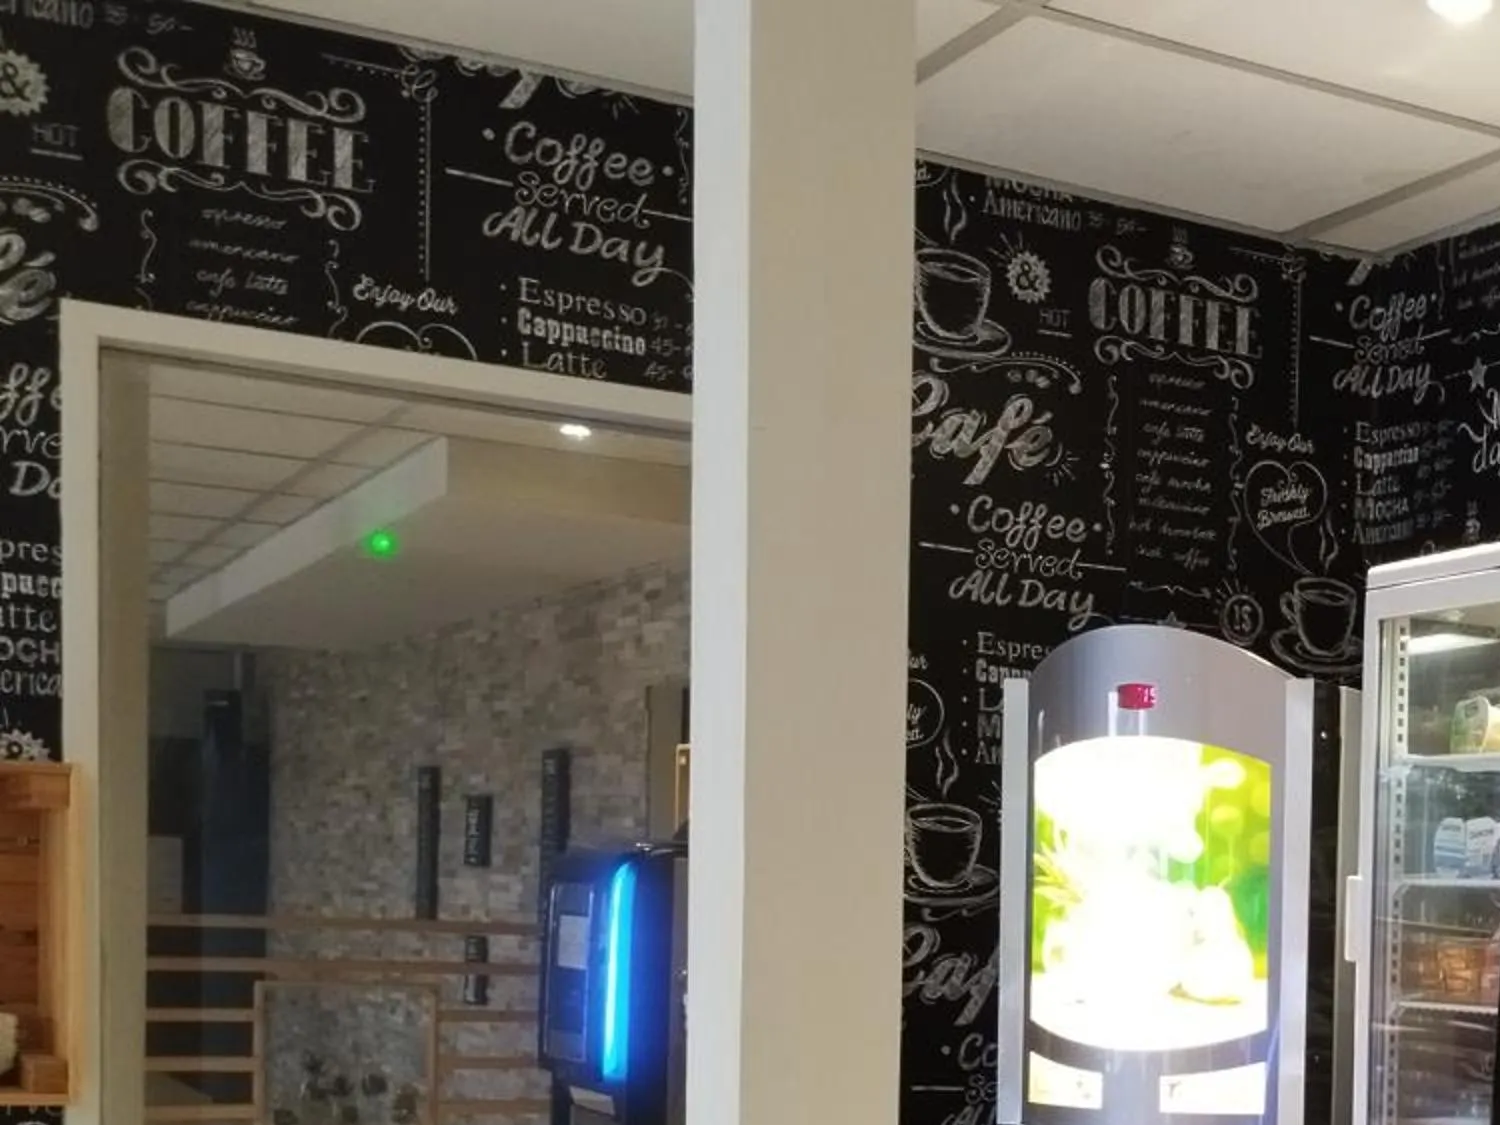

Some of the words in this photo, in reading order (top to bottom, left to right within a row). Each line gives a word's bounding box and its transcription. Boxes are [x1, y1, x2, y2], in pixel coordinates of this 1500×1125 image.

[32, 124, 80, 147] HOT
[107, 87, 376, 193] COFFEE
[504, 120, 654, 190] Coffee
[514, 171, 651, 228] Served
[981, 189, 1082, 231] Americano
[482, 204, 563, 249] All
[569, 221, 665, 287] Day
[353, 274, 415, 311] Enjoy
[417, 287, 458, 315] Our
[518, 277, 646, 325] Espresso
[1088, 277, 1263, 358] COFFEE
[1350, 292, 1427, 342] Coffee
[517, 307, 646, 356] Cappuccino
[522, 341, 607, 379] Latte
[1385, 362, 1432, 406] Day
[966, 495, 1087, 551] Coffee
[975, 539, 1084, 580] Served
[948, 570, 1012, 607] All
[1018, 578, 1096, 631] Day
